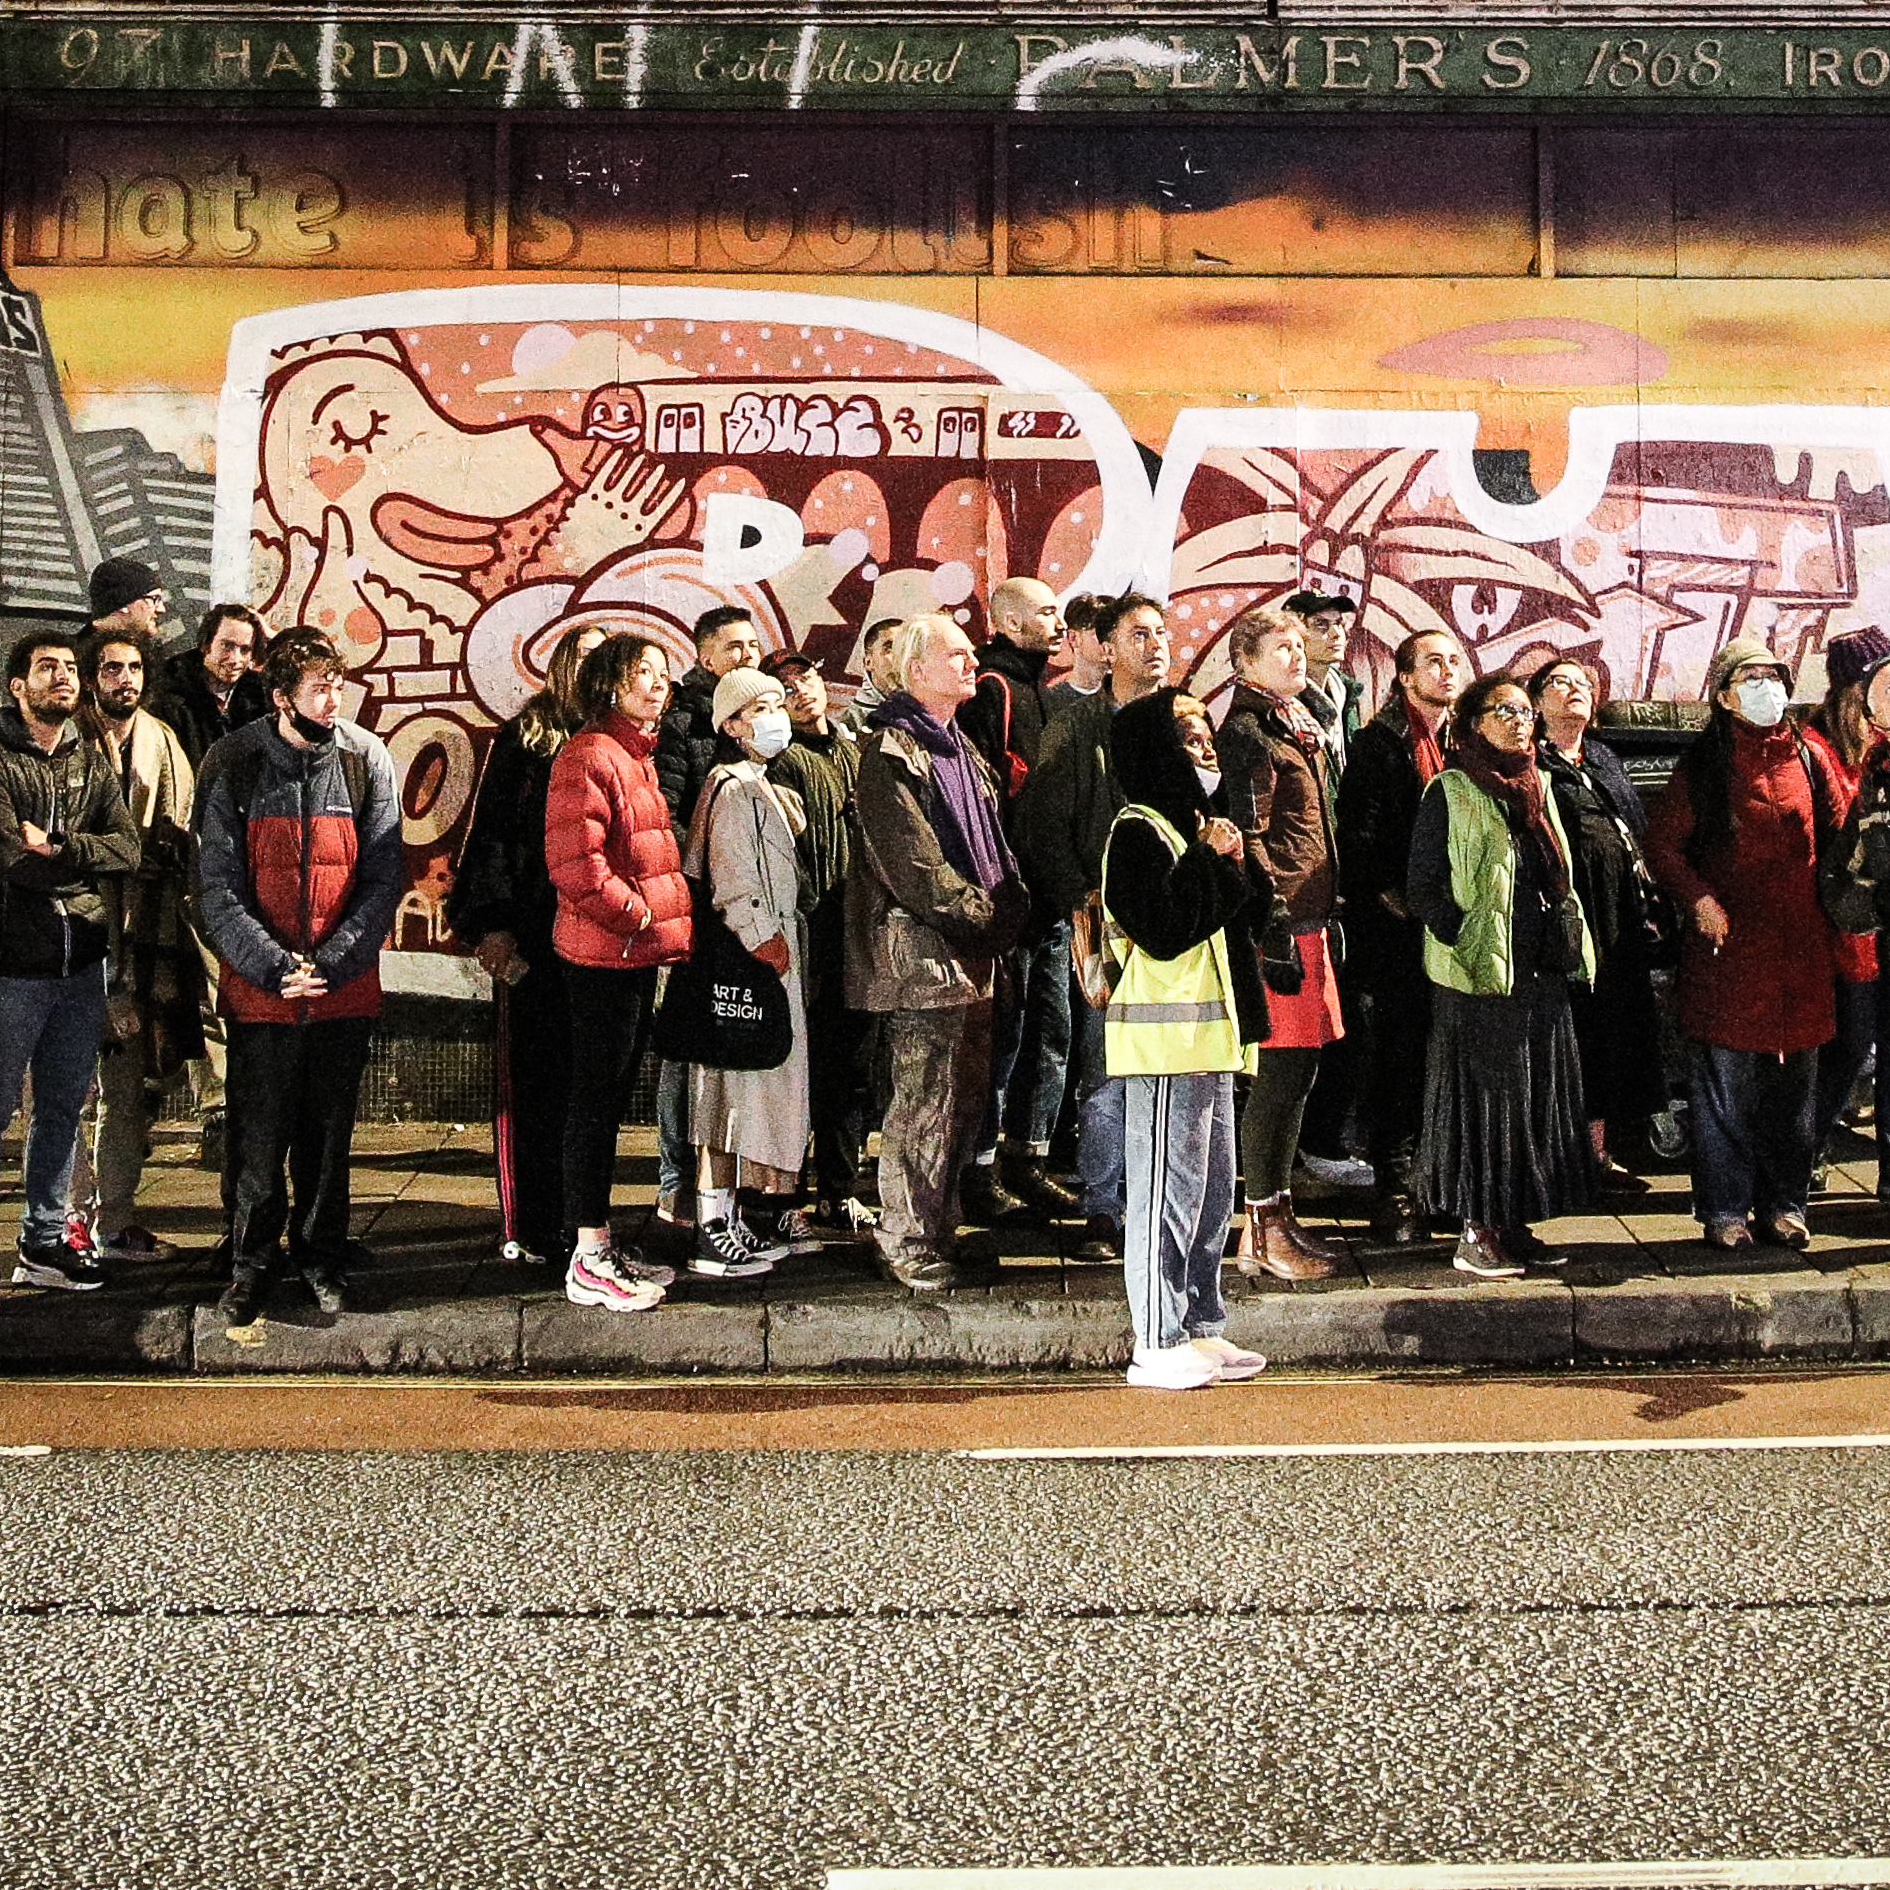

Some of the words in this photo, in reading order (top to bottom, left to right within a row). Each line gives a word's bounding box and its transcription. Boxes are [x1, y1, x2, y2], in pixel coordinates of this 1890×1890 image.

[712, 983, 740, 1001] ART
[742, 988, 754, 1003] &
[710, 1000, 764, 1021] DESIGN
